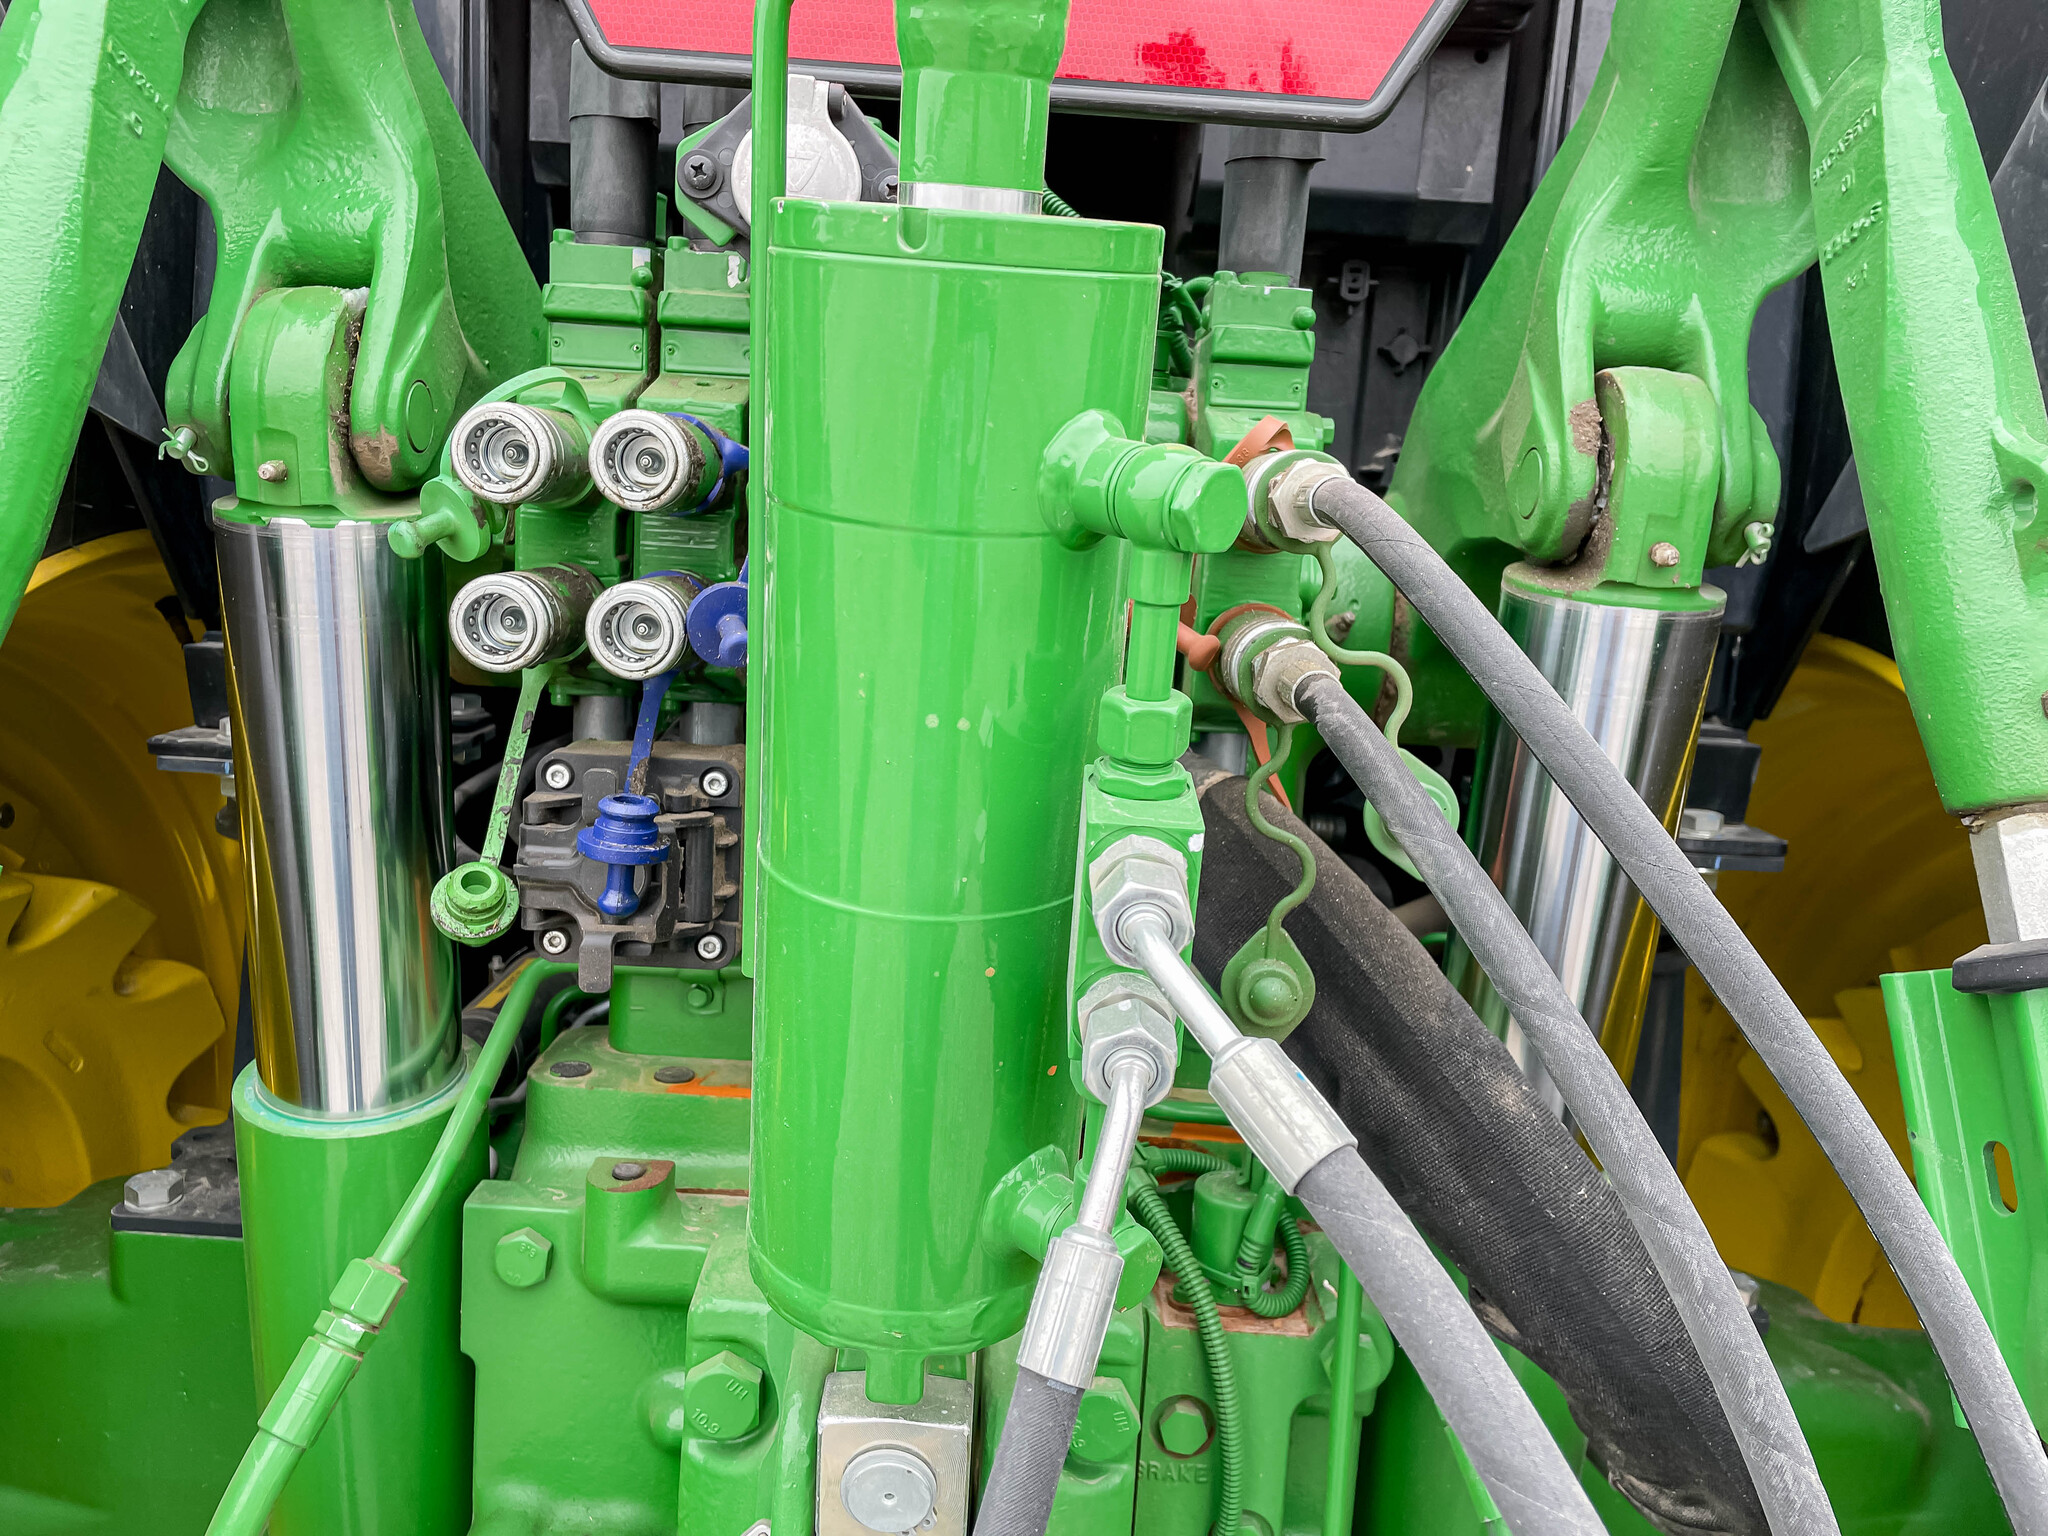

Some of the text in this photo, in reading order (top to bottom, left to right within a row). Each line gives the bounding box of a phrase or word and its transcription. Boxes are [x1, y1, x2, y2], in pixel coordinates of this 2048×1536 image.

[725, 1378, 749, 1400] UH
[691, 1407, 721, 1435] 10.9
[1113, 1410, 1130, 1432] UH
